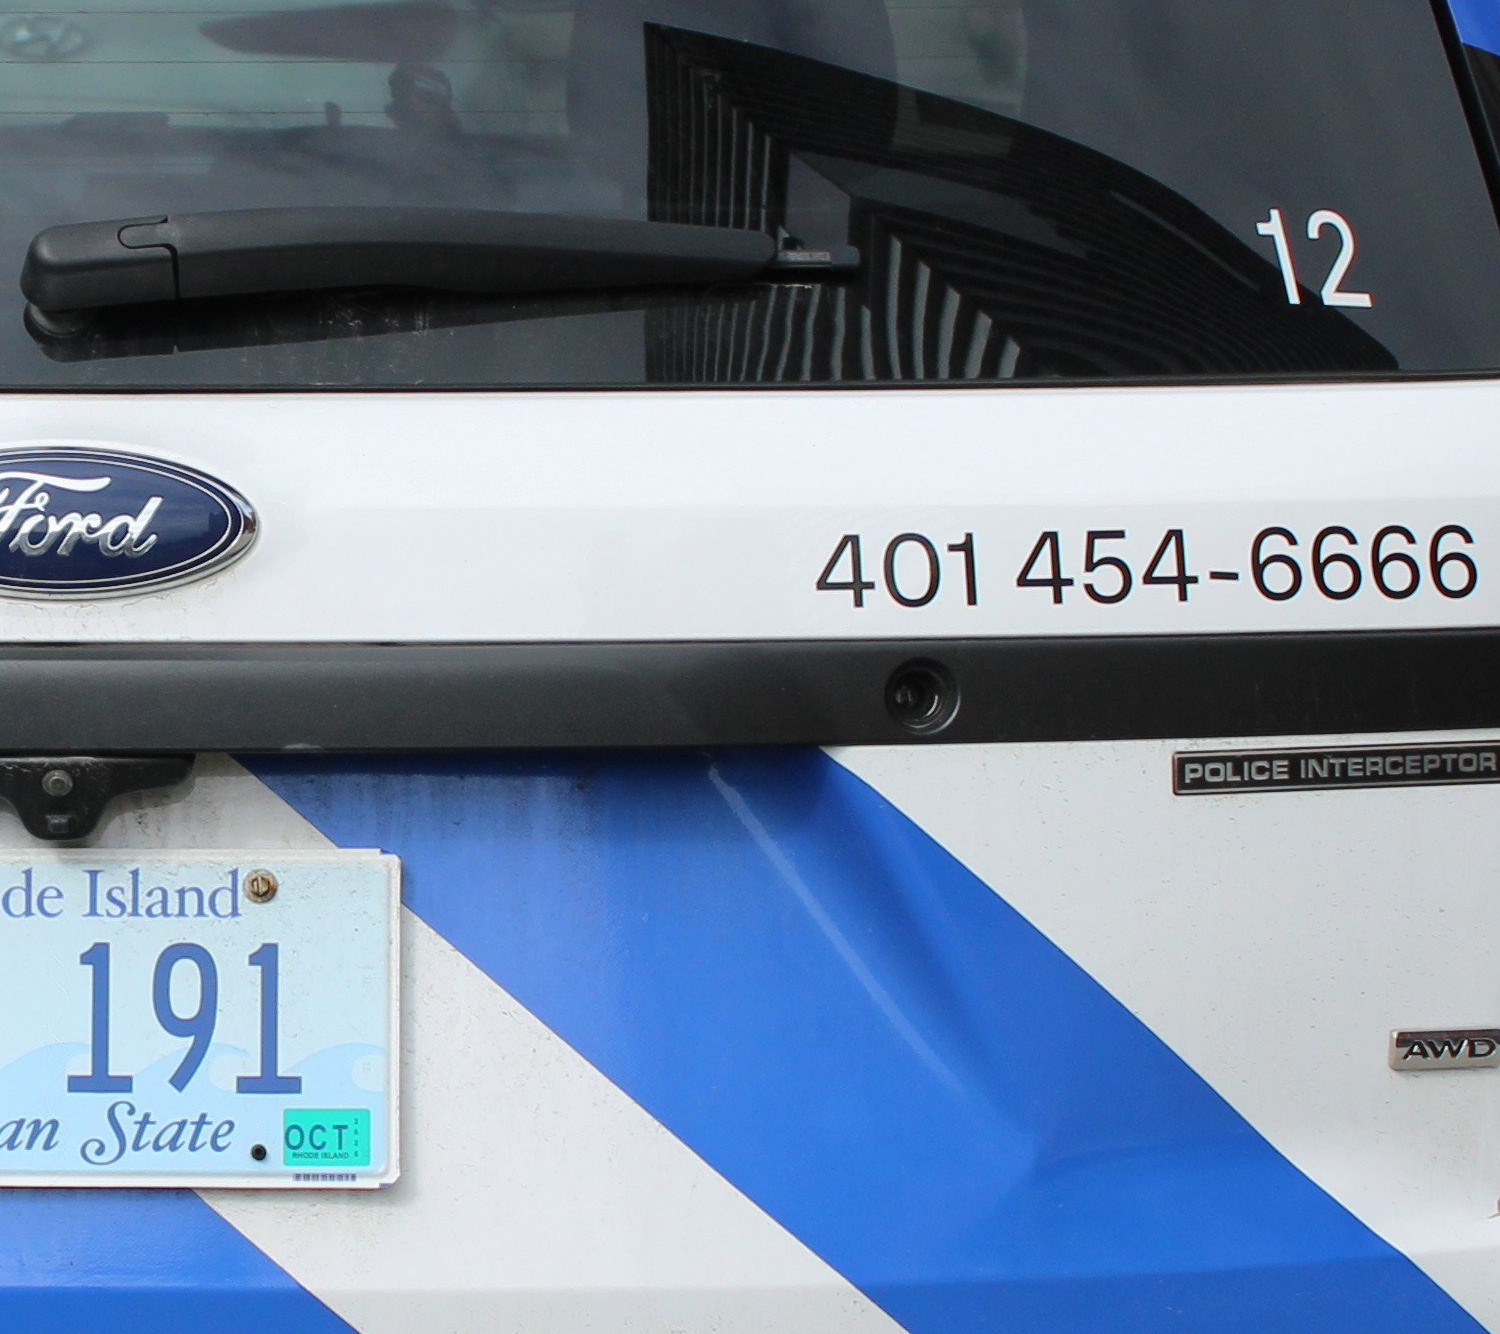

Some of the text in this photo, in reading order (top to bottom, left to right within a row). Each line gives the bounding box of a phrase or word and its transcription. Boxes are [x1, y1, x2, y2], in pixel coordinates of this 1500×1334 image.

[1256, 208, 1374, 308] 12
[816, 524, 1479, 608] 401 454-6666
[1184, 752, 1497, 783] POLICE INTERCEPTOR
[81, 868, 242, 919] Island
[66, 942, 303, 1095] 191
[1401, 1038, 1497, 1061] AWD
[79, 1100, 236, 1165] State
[285, 1124, 349, 1150] OCT
